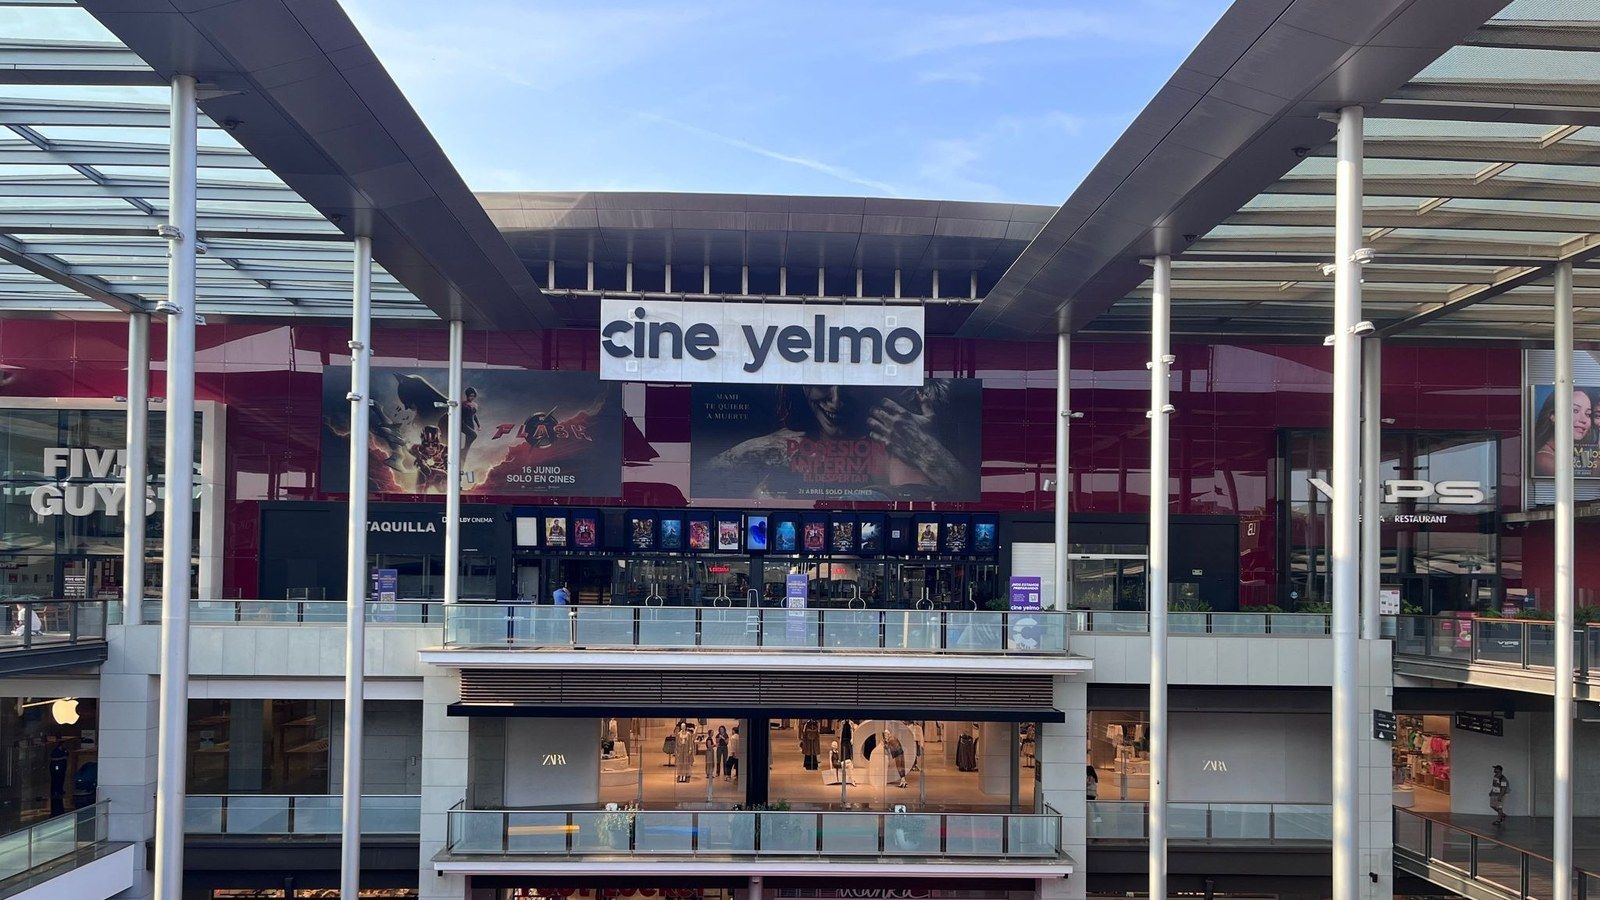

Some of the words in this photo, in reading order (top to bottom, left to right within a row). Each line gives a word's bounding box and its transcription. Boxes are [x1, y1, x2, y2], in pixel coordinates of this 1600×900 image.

[601, 307, 719, 360] cine
[741, 315, 923, 373] yelmo
[521, 466, 532, 475] 16
[533, 466, 561, 475] JUNIO
[506, 475, 532, 483] SOLO
[533, 475, 547, 483] EN
[548, 475, 576, 484] CINES
[1394, 515, 1448, 524] RESTAURANT
[542, 754, 567, 766] ZARA
[1202, 760, 1227, 771] ZARA
